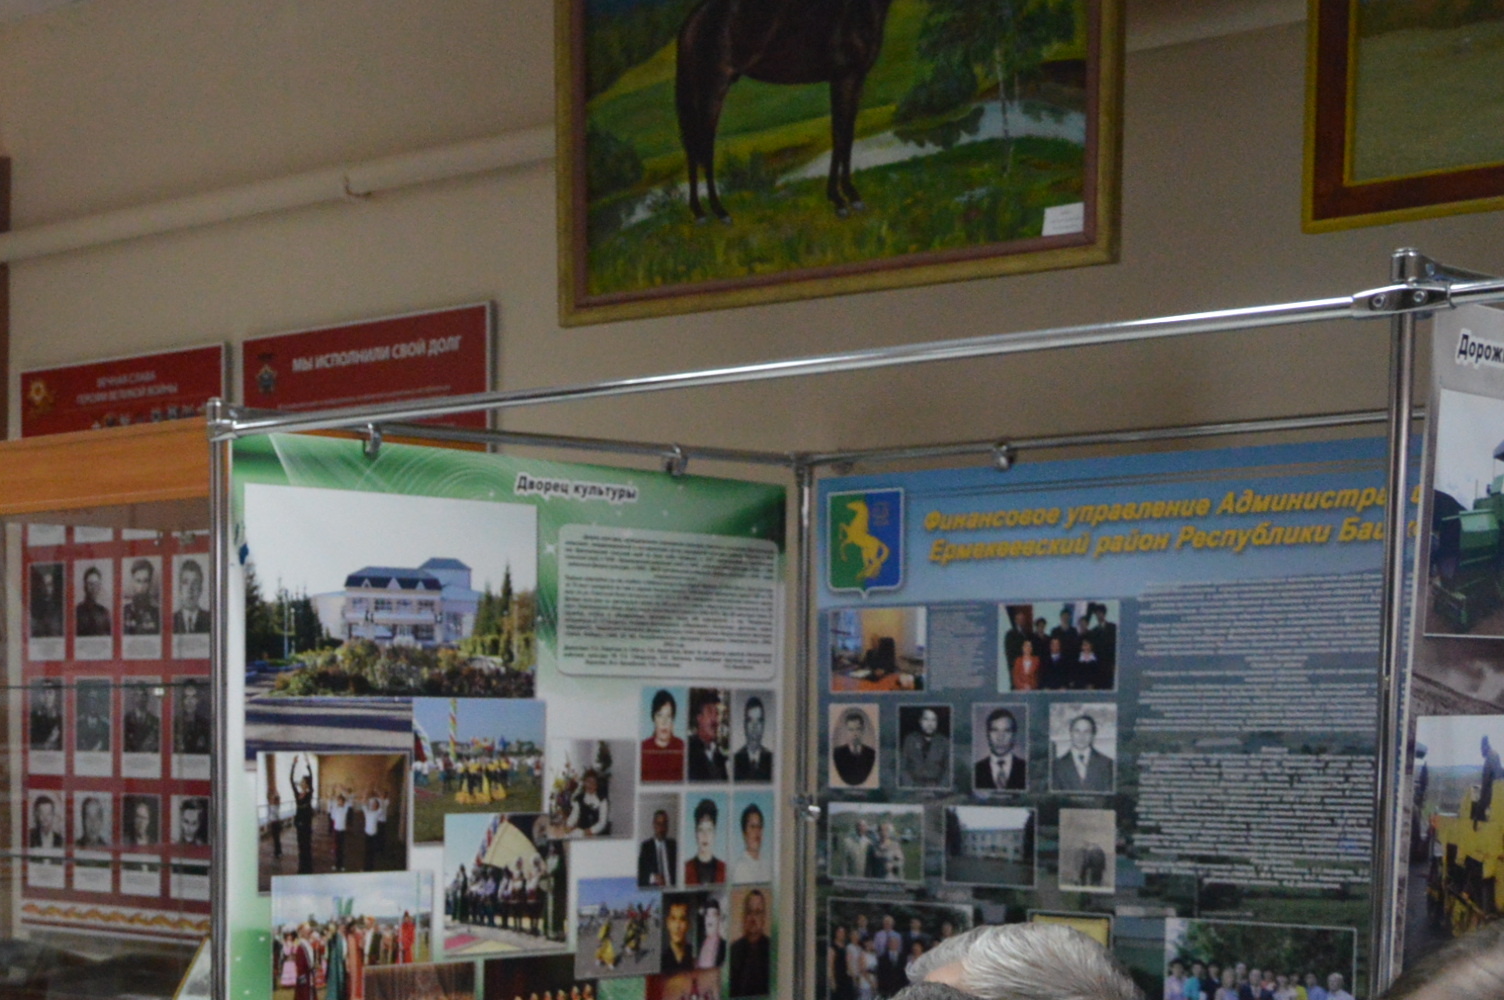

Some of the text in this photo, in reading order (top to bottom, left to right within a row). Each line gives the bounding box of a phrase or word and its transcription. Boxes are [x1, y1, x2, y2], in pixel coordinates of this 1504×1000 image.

[292, 335, 462, 372] МЫ ИСПОЛНИЛИ СВОЙ ДОЛГ
[517, 475, 637, 501] Дворец культуры
[924, 508, 1061, 531] Финансовое
[1064, 499, 1211, 529] управление
[929, 532, 1091, 566] Ермекеевский
[1092, 529, 1171, 557] район
[1176, 521, 1333, 555] Республики
